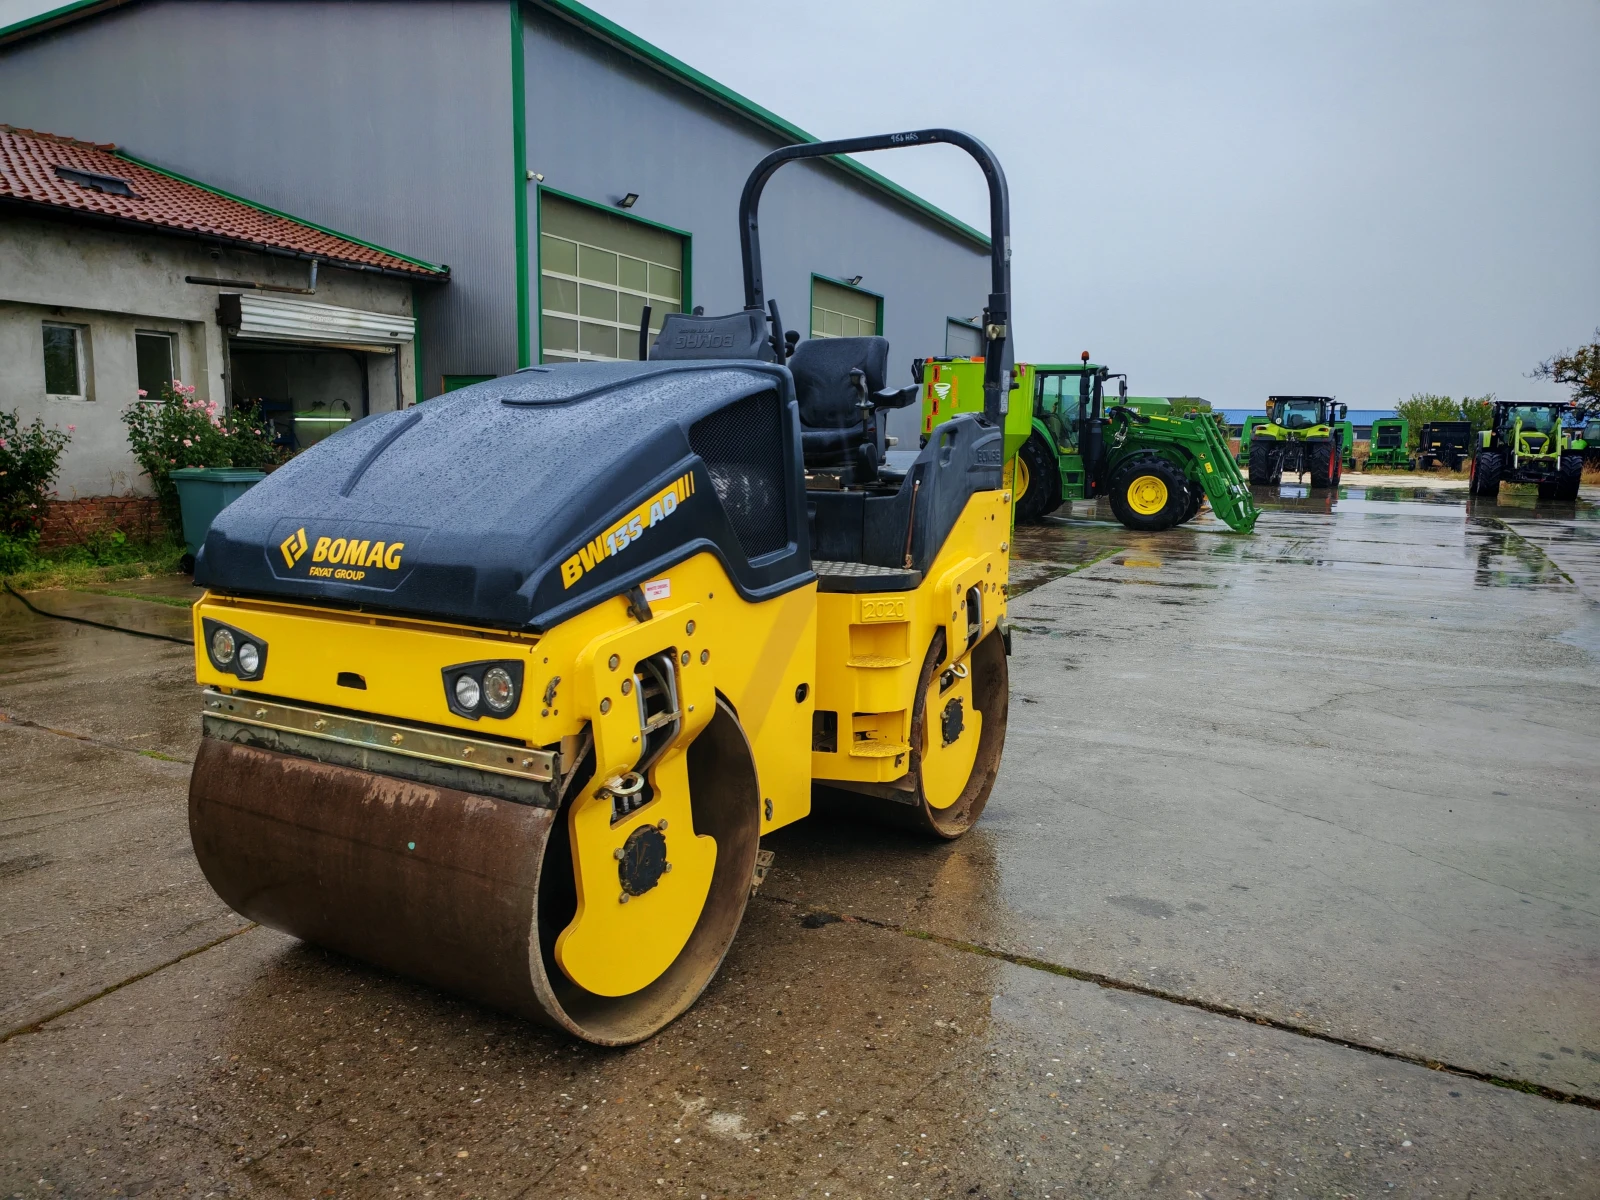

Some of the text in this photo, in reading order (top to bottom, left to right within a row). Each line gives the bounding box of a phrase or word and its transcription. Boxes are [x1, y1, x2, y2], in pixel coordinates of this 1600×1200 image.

[650, 491, 678, 528] AD
[312, 537, 405, 570] BOMAG
[309, 566, 365, 581] FAYAT GROUP
[863, 601, 905, 619] 2020
